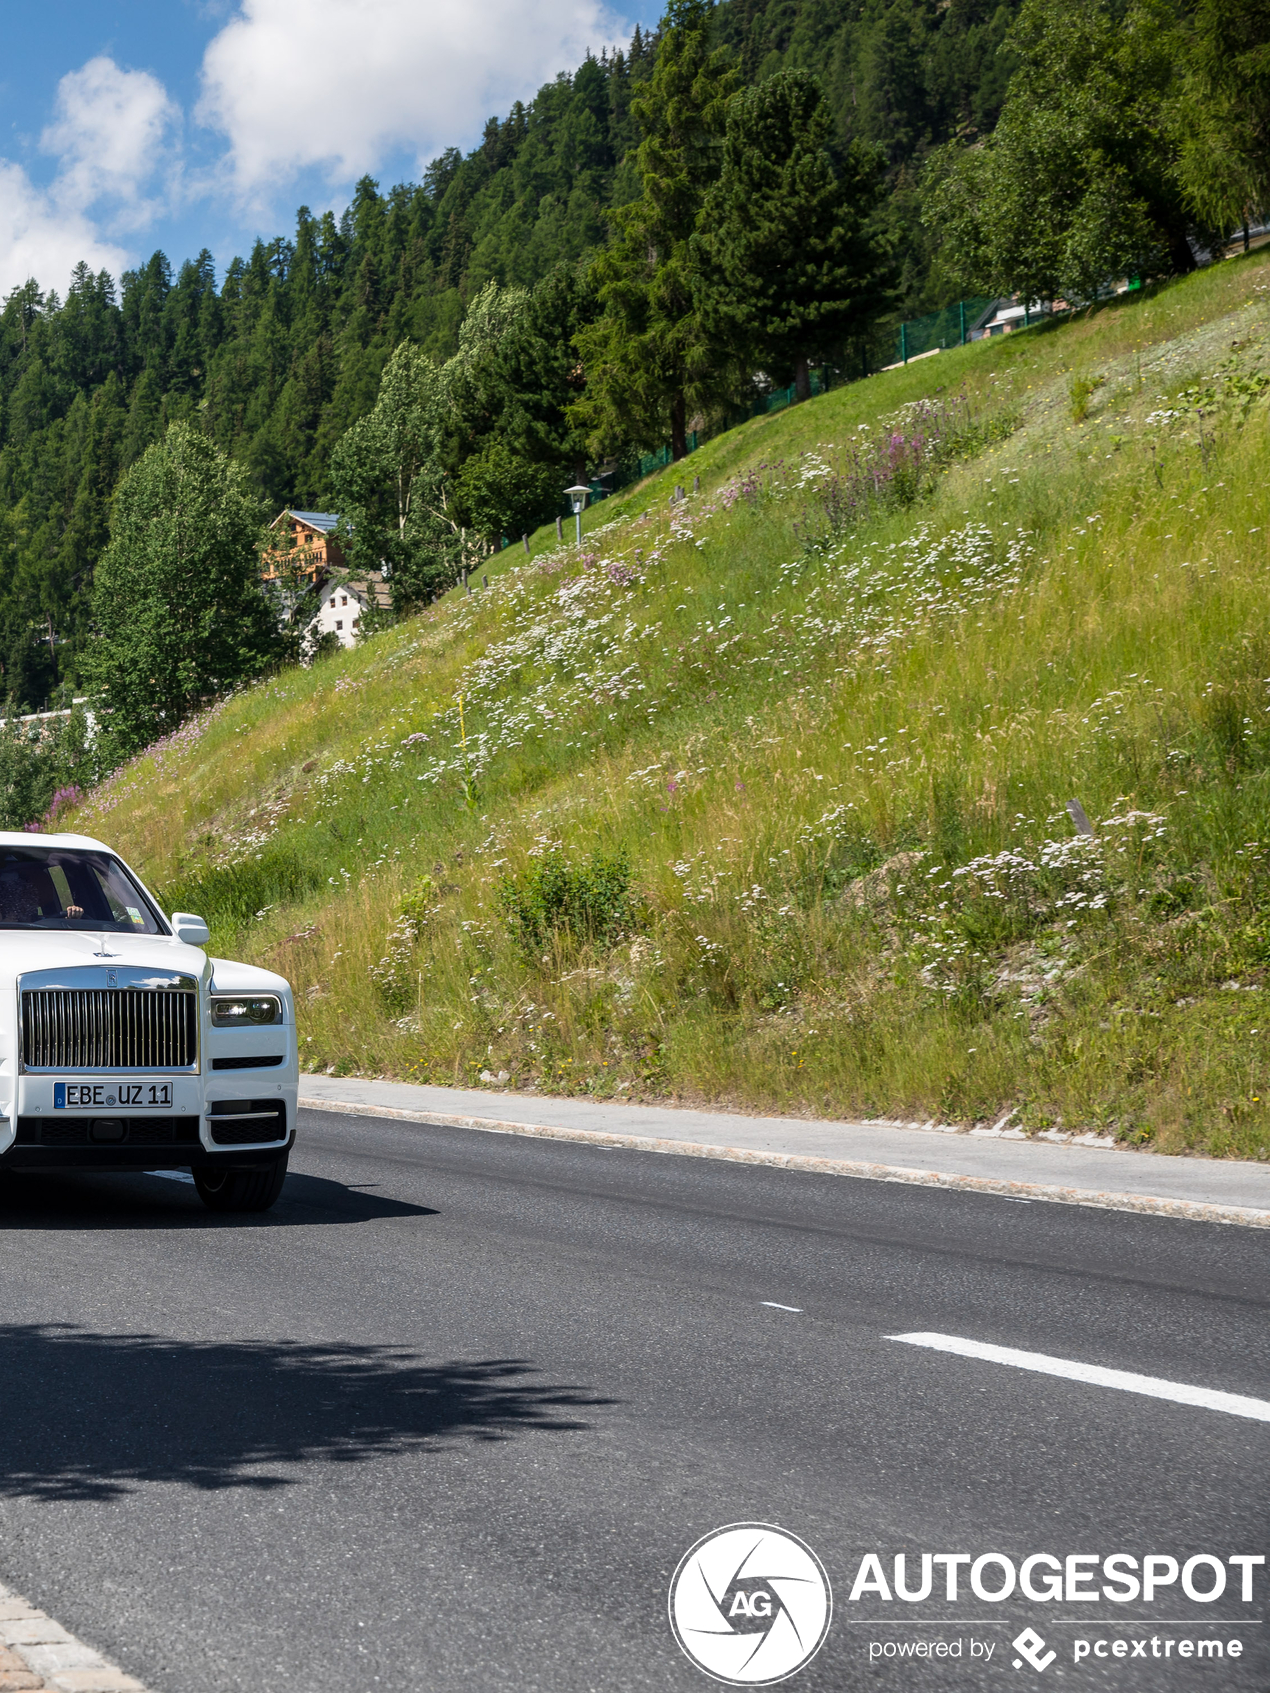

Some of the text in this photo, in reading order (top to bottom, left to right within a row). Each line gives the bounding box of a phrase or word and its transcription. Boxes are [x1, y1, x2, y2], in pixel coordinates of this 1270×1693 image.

[67, 1086, 170, 1105] EBE UZ 11
